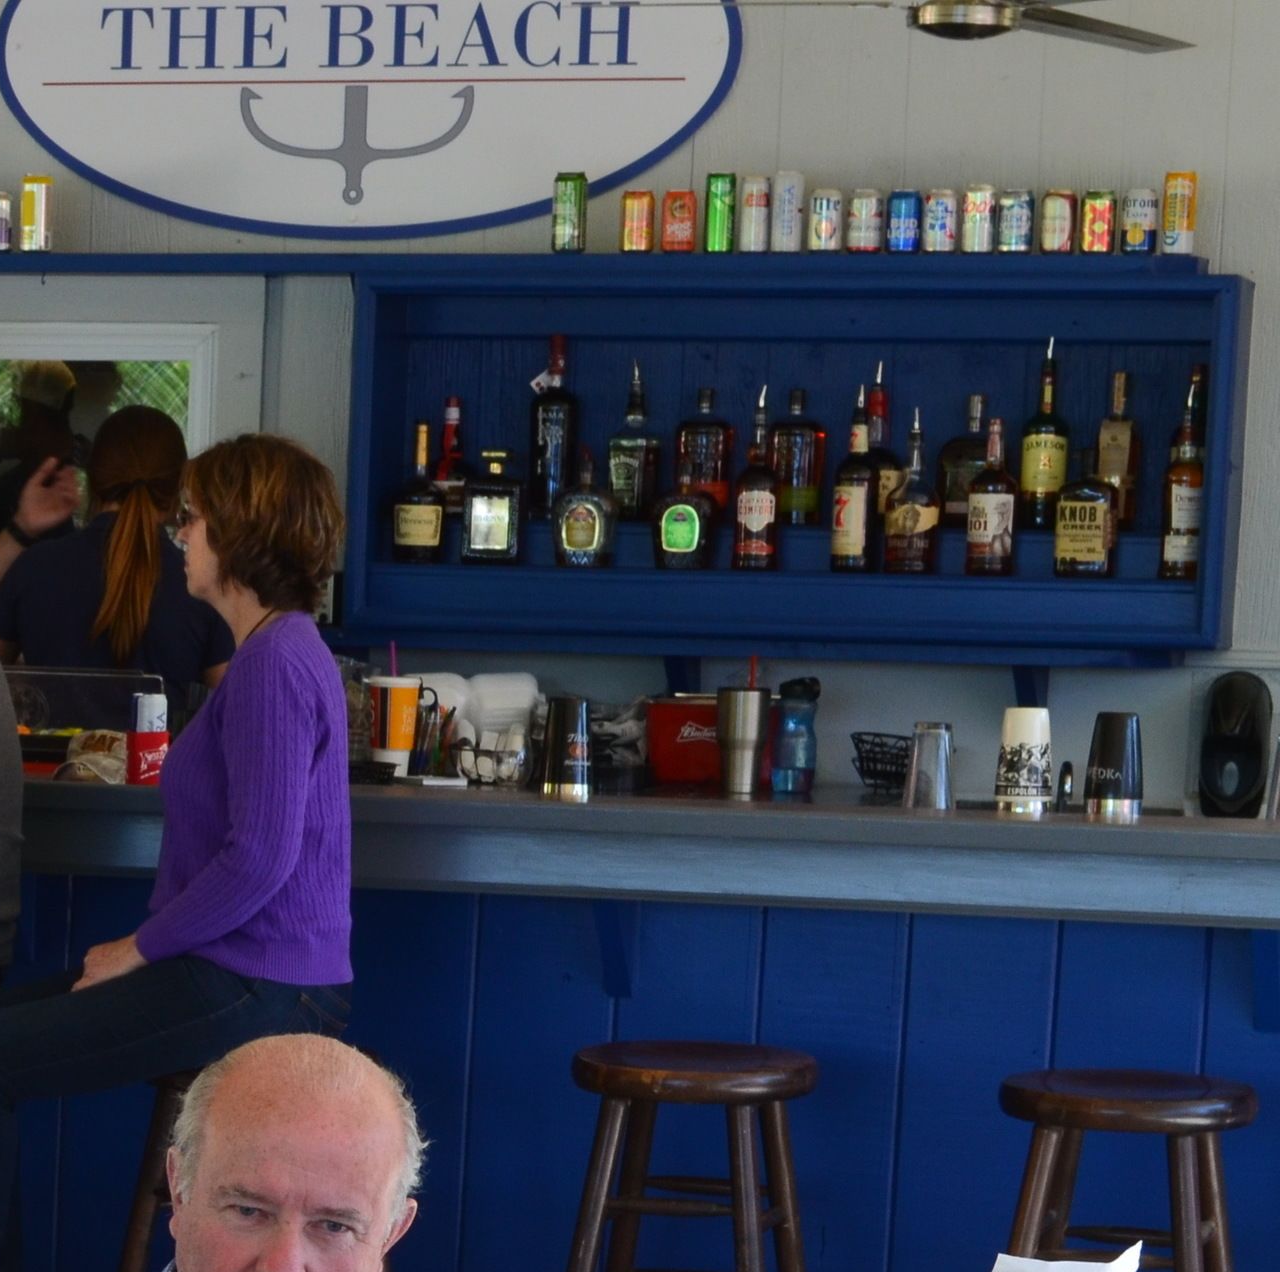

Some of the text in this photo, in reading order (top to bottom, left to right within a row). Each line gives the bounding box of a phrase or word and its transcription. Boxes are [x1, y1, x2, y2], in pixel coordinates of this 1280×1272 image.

[101, 1, 638, 70] THE BEACH
[1060, 506, 1097, 522] KNOB
[969, 520, 988, 532] 101
